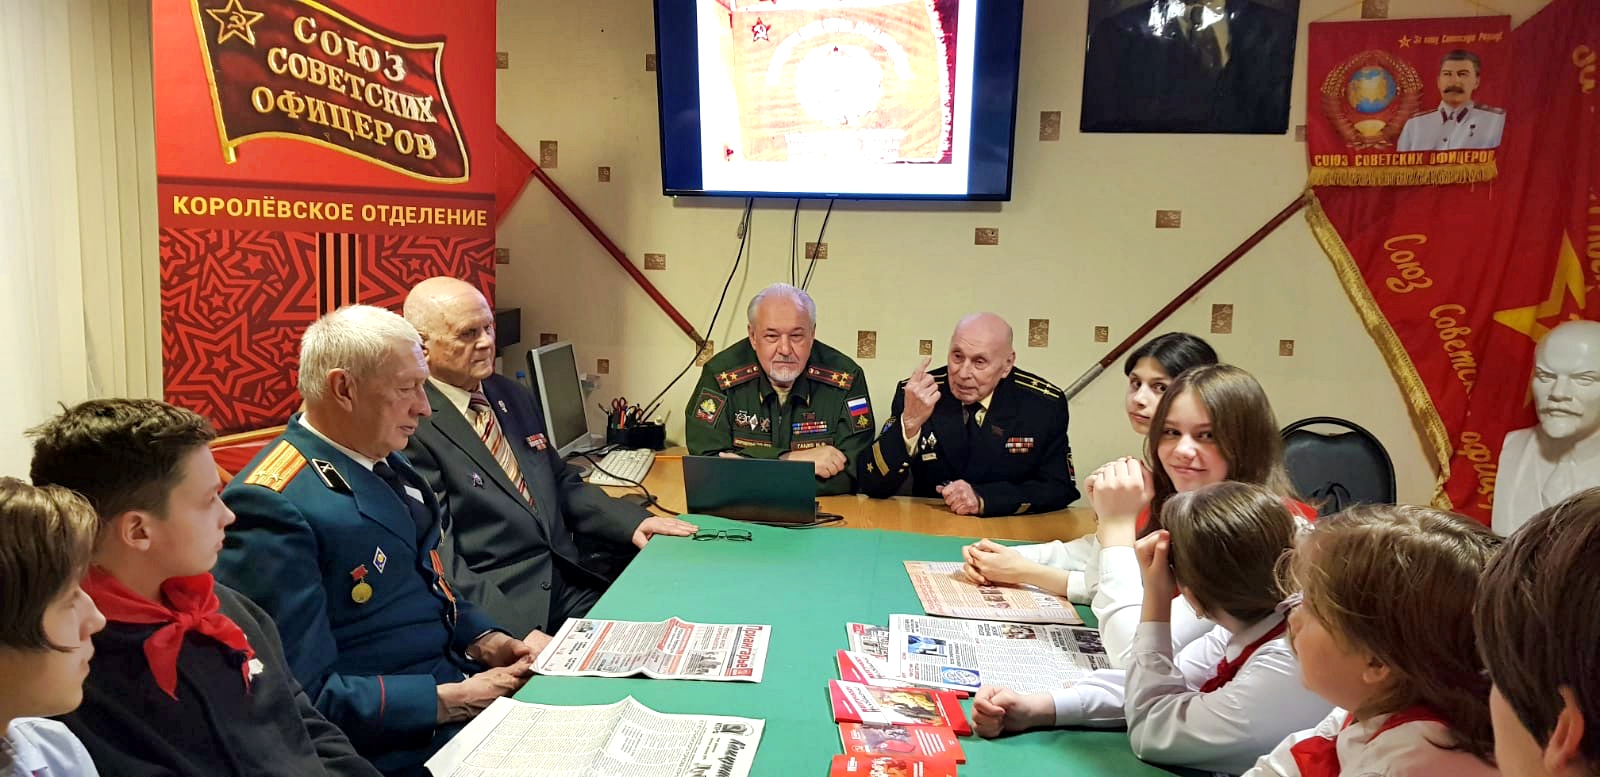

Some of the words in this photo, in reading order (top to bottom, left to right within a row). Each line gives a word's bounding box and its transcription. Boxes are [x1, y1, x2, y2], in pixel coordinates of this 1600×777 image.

[293, 16, 407, 82] СОЮЗ
[267, 47, 437, 123] СОВЕТСКИХ
[252, 86, 437, 160] ОФИЦЕРОВ
[1314, 154, 1348, 167] СОЮЗ
[1355, 152, 1424, 167] СОВЕТСКИХ
[173, 195, 354, 222] КОРОЛЁВСКОЕ
[361, 203, 487, 227] ОТДЕЛЕНИЕ
[1383, 233, 1433, 294] Союз
